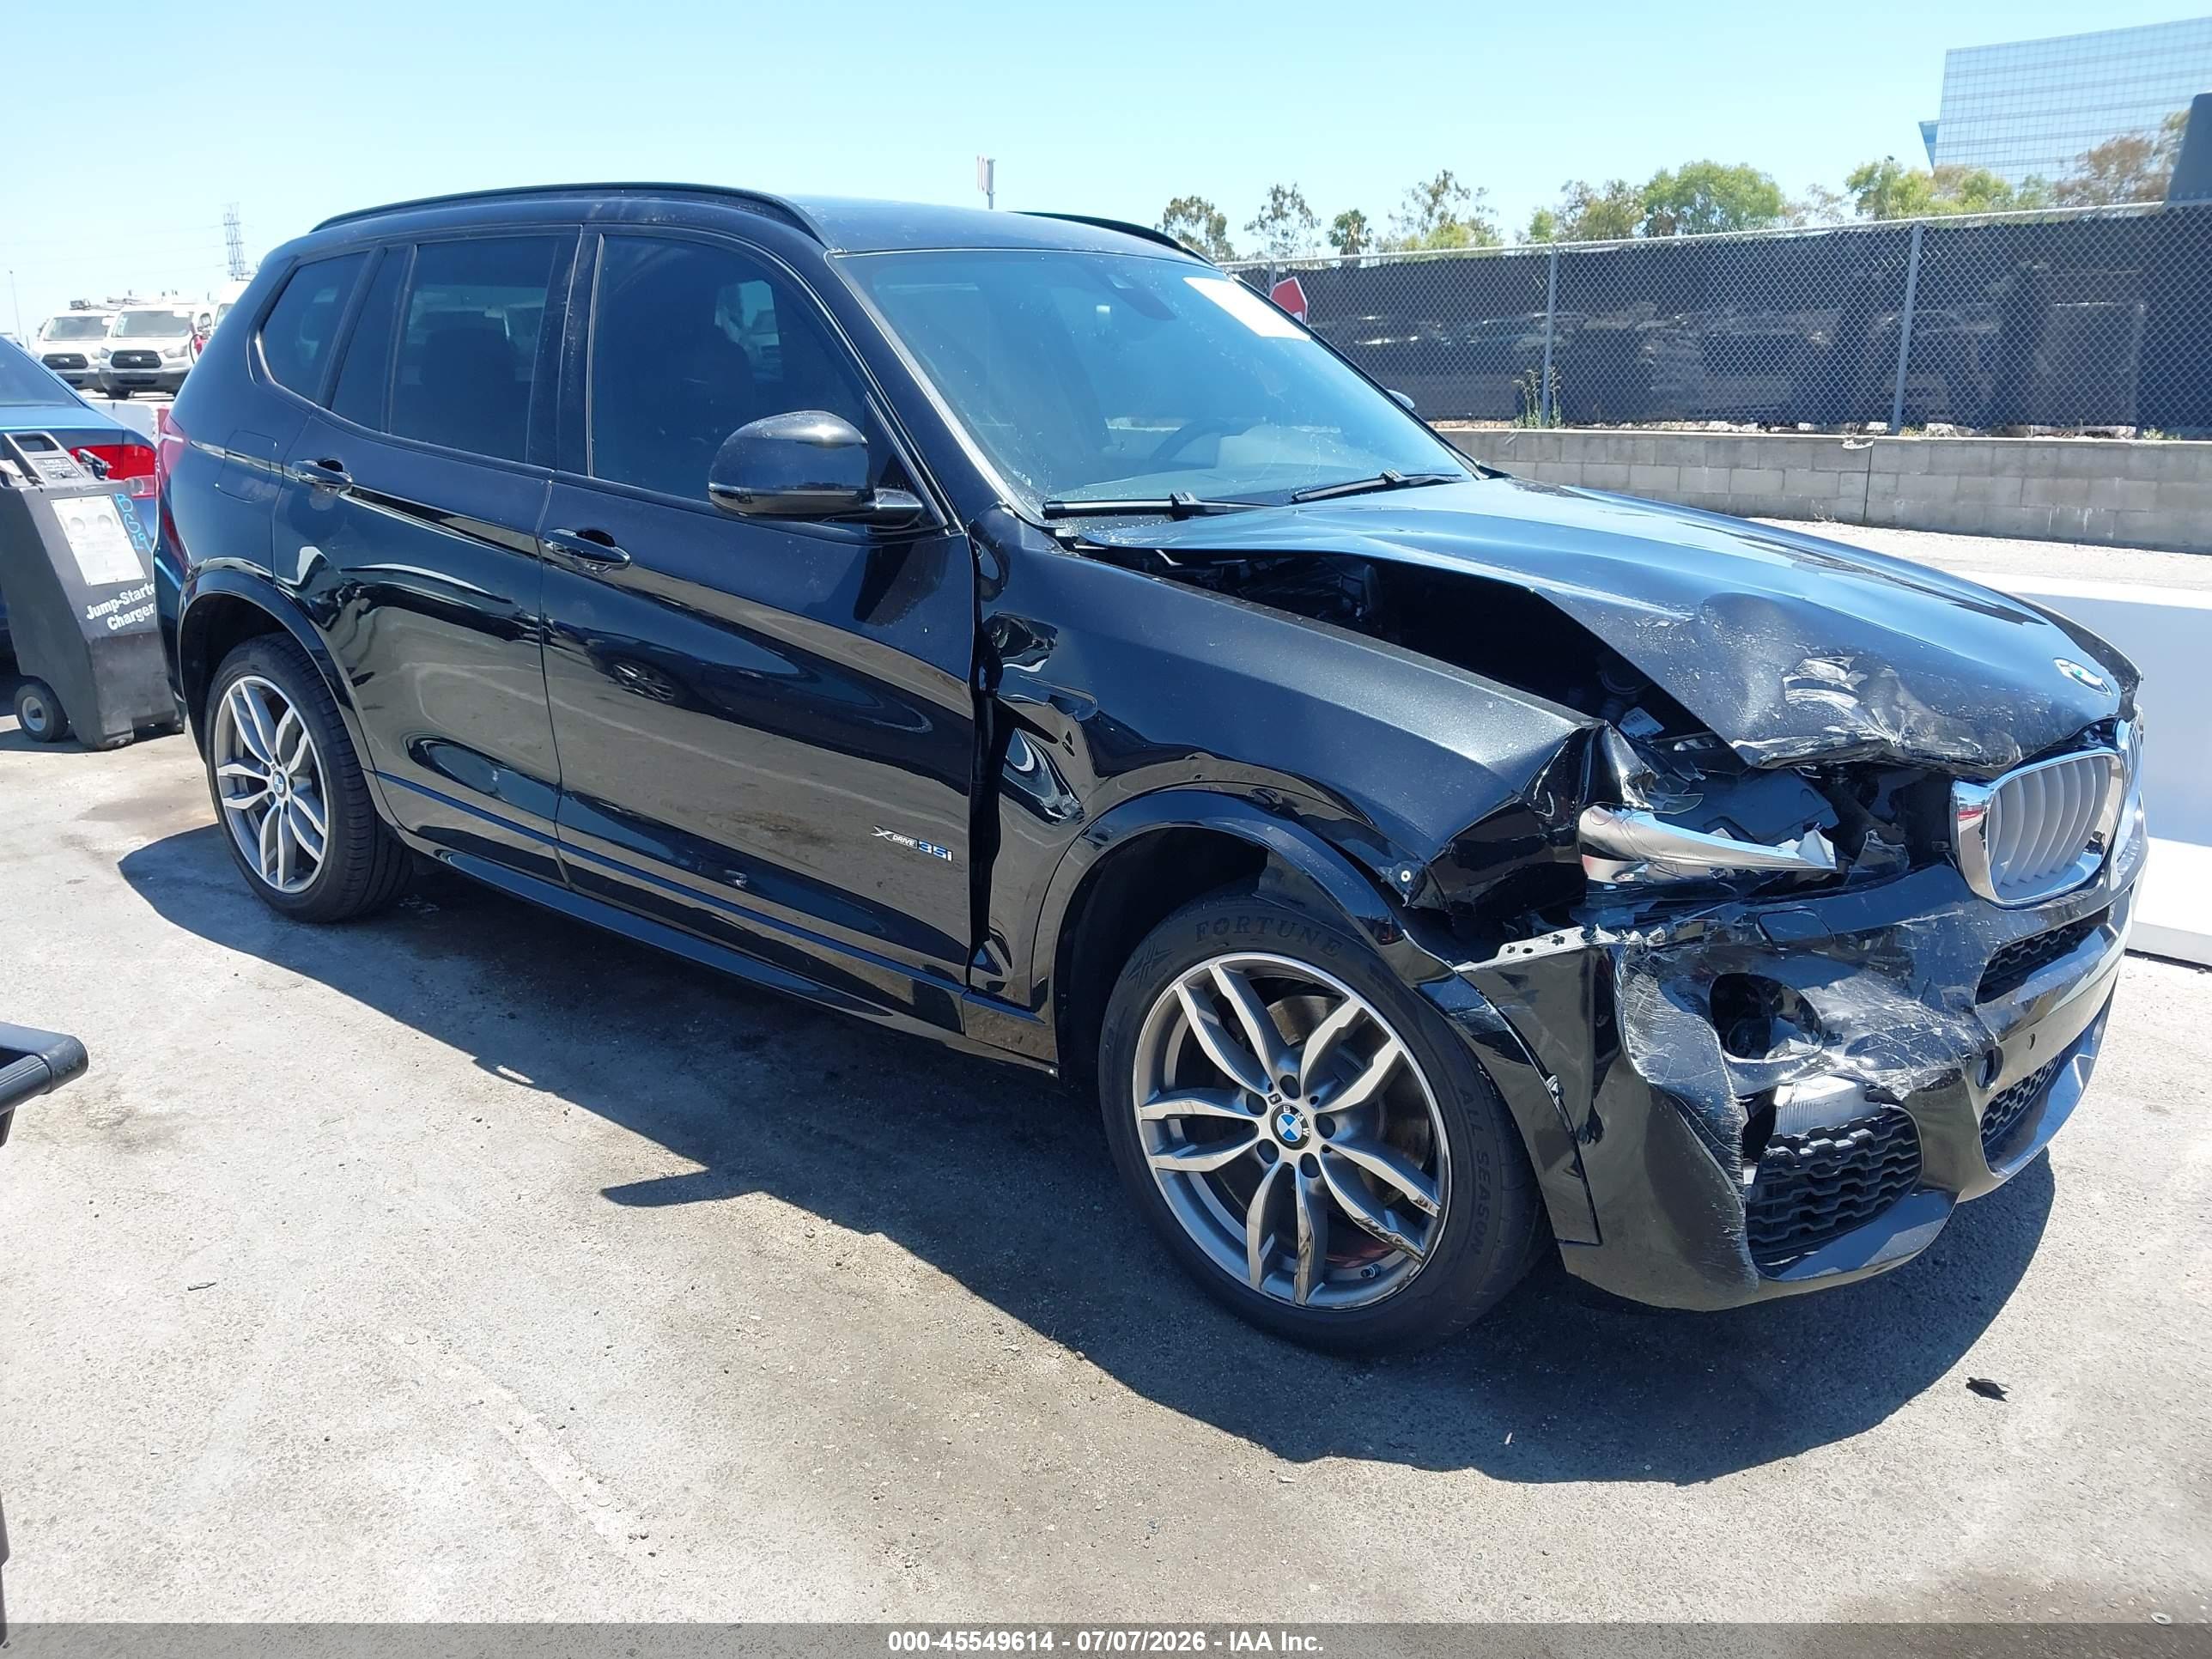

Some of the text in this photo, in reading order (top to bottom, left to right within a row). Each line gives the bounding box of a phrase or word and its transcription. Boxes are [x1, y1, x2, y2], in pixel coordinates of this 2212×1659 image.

[106, 603, 155, 630] Charger
[1194, 915, 1345, 958] FORTUNE
[1283, 1105, 1310, 1137] BMW
[1460, 1088, 1491, 1255] ALL SEASON
